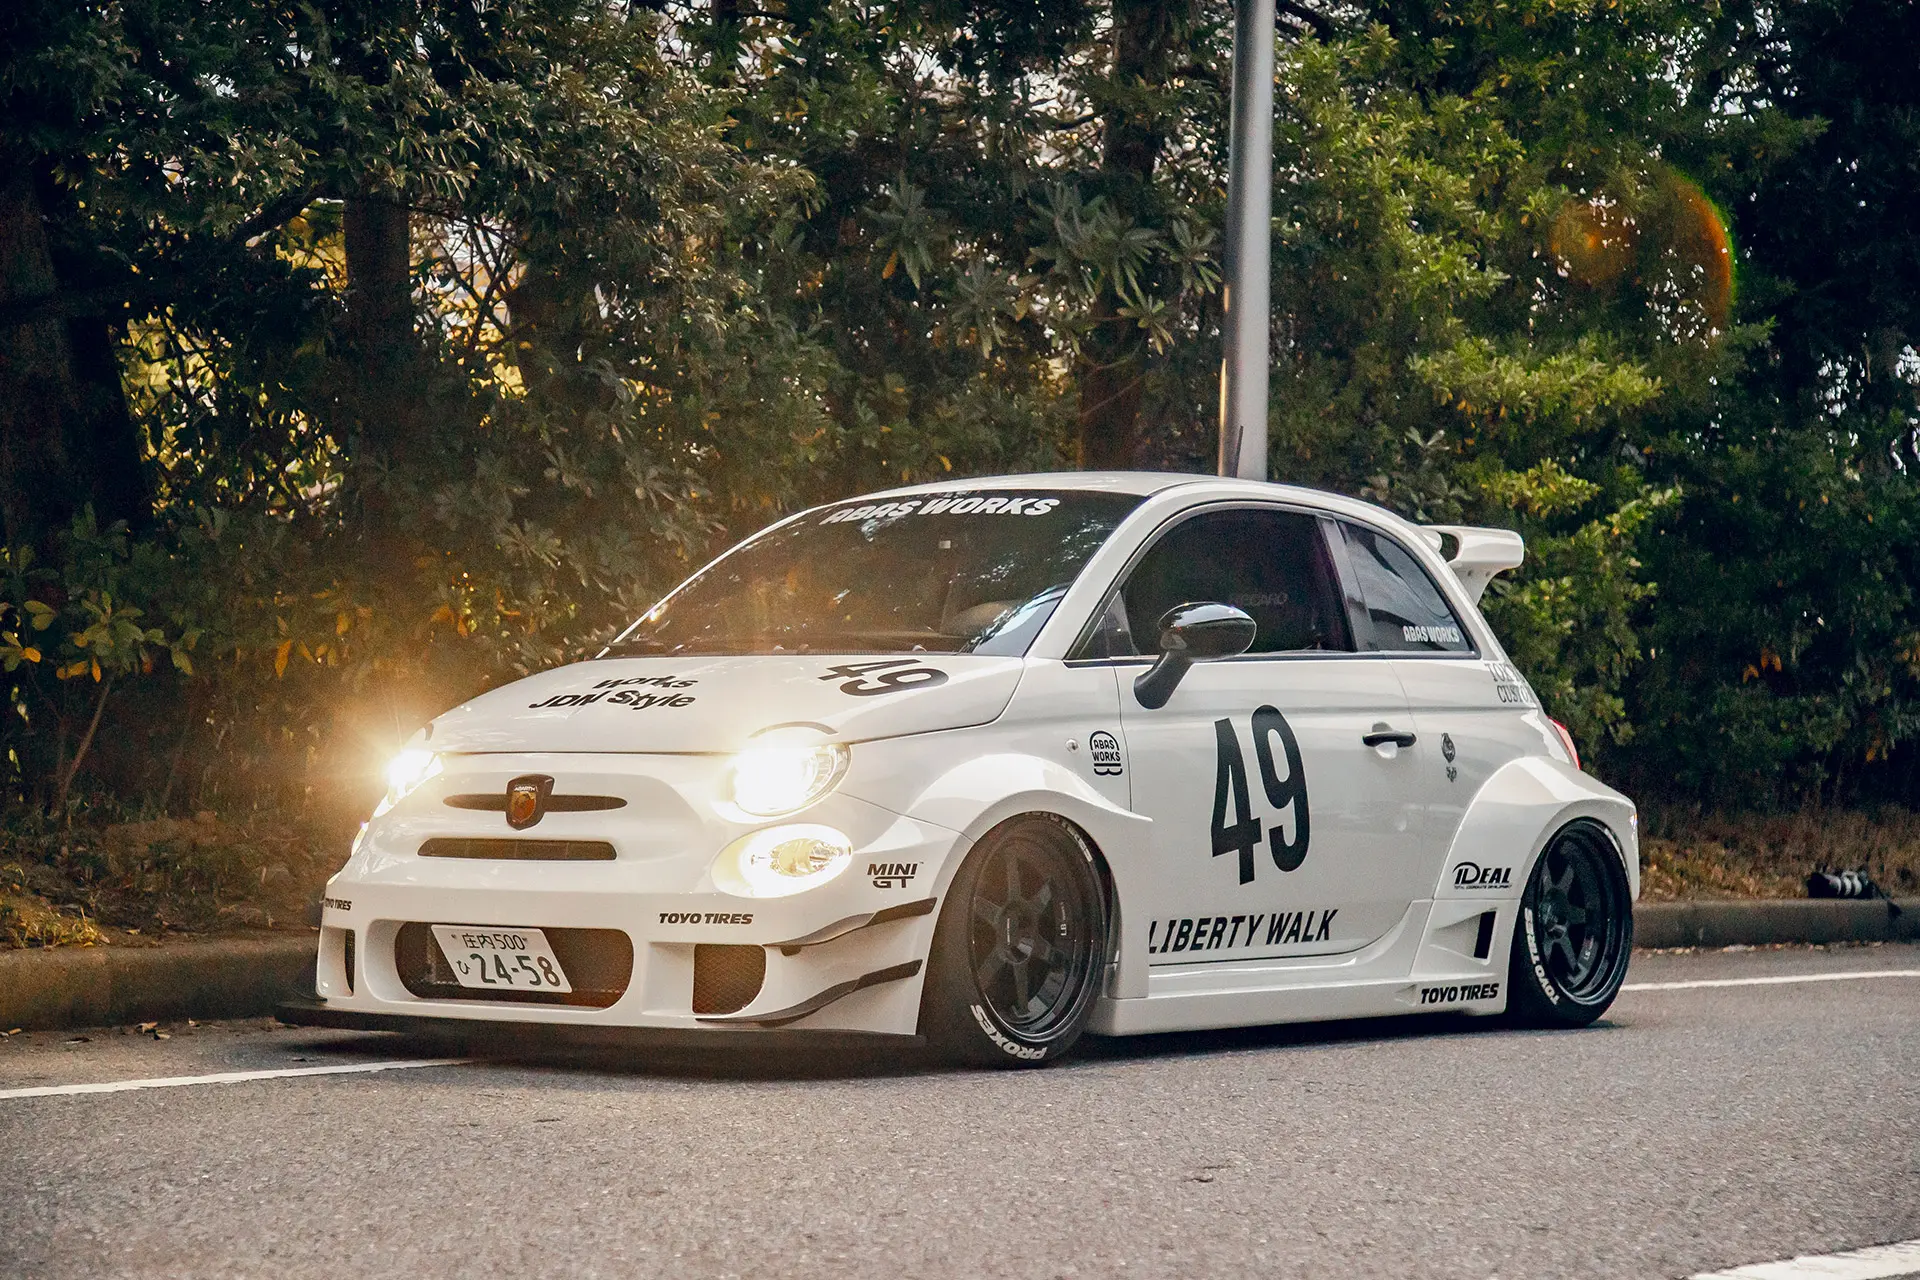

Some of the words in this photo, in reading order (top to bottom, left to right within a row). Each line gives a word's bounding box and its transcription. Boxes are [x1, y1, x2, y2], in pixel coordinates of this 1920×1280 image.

[819, 501, 922, 525] ABAS
[918, 498, 1060, 515] WORKS
[1402, 626, 1428, 641] ABAS
[1427, 627, 1459, 642] WORKS
[817, 659, 949, 696] 49
[607, 690, 696, 710] Style
[1093, 739, 1115, 750] ABAS
[1091, 751, 1121, 762] WORKS
[1211, 704, 1310, 885] 49
[867, 863, 918, 876] MINI
[1452, 861, 1512, 885] IDEAL
[872, 876, 915, 889] GT
[659, 913, 702, 924] TOYO
[704, 913, 754, 925] TIRES
[1149, 914, 1265, 954] LIBERTY
[1265, 909, 1339, 945] WALK
[469, 953, 561, 987] 24-58
[1421, 986, 1459, 1004] TOYO
[1460, 982, 1500, 1001] TIRES
[970, 1004, 1048, 1060] PROXES
